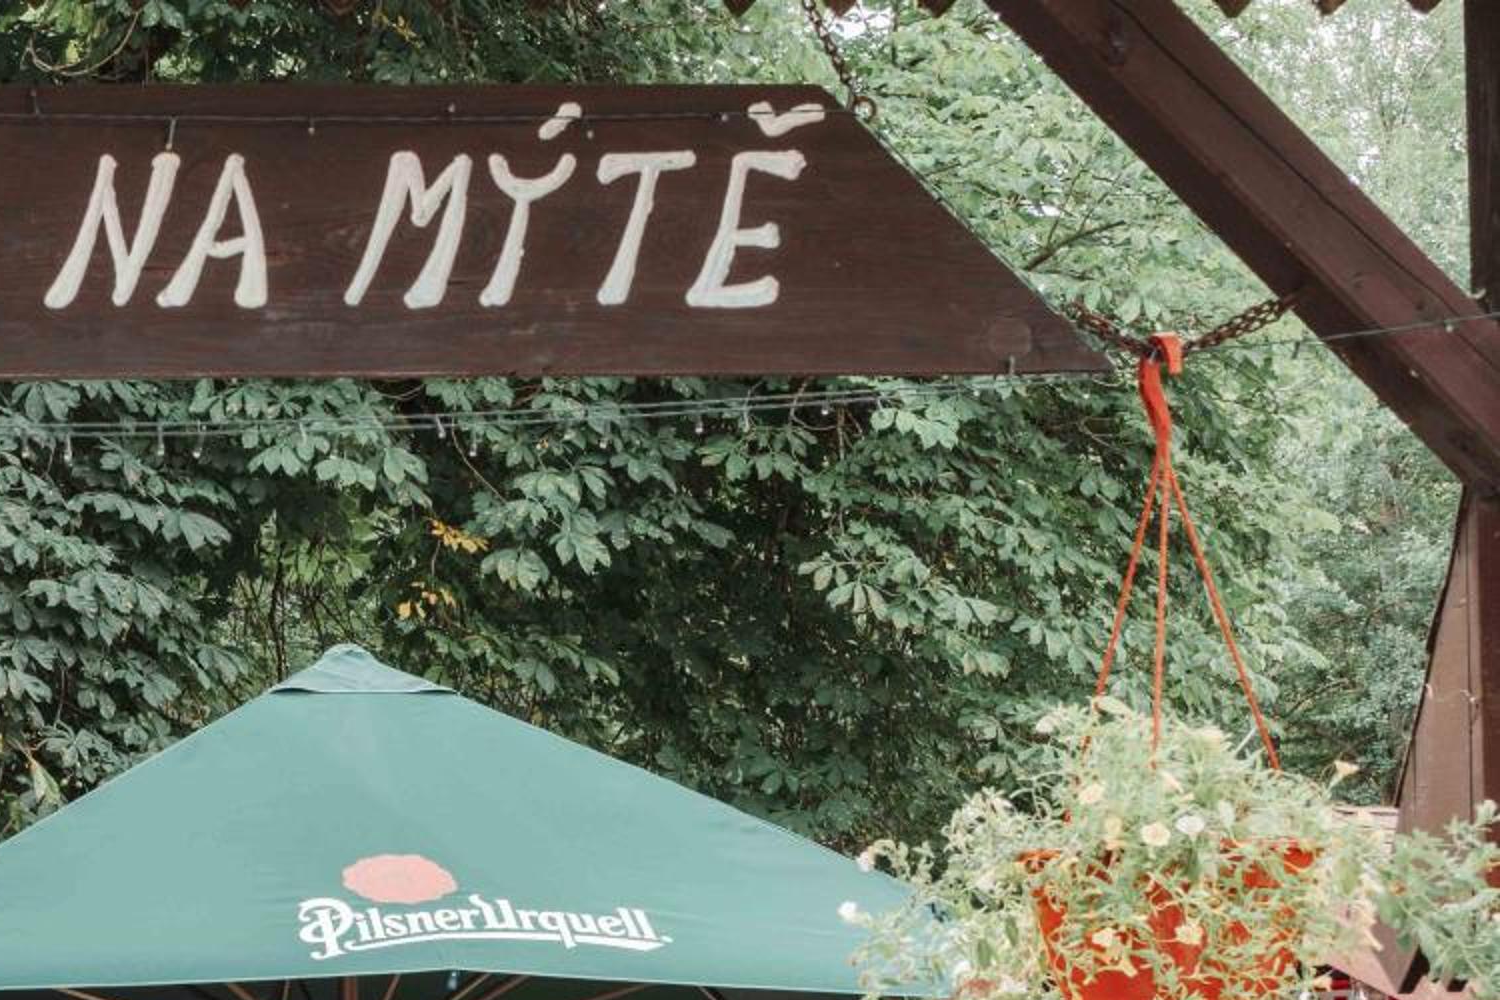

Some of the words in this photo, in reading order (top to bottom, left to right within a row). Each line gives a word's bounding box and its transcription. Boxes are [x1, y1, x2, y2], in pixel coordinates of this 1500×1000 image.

[43, 151, 269, 309] NA
[344, 101, 826, 309] MÝTĚ
[297, 896, 478, 961] Pilsner
